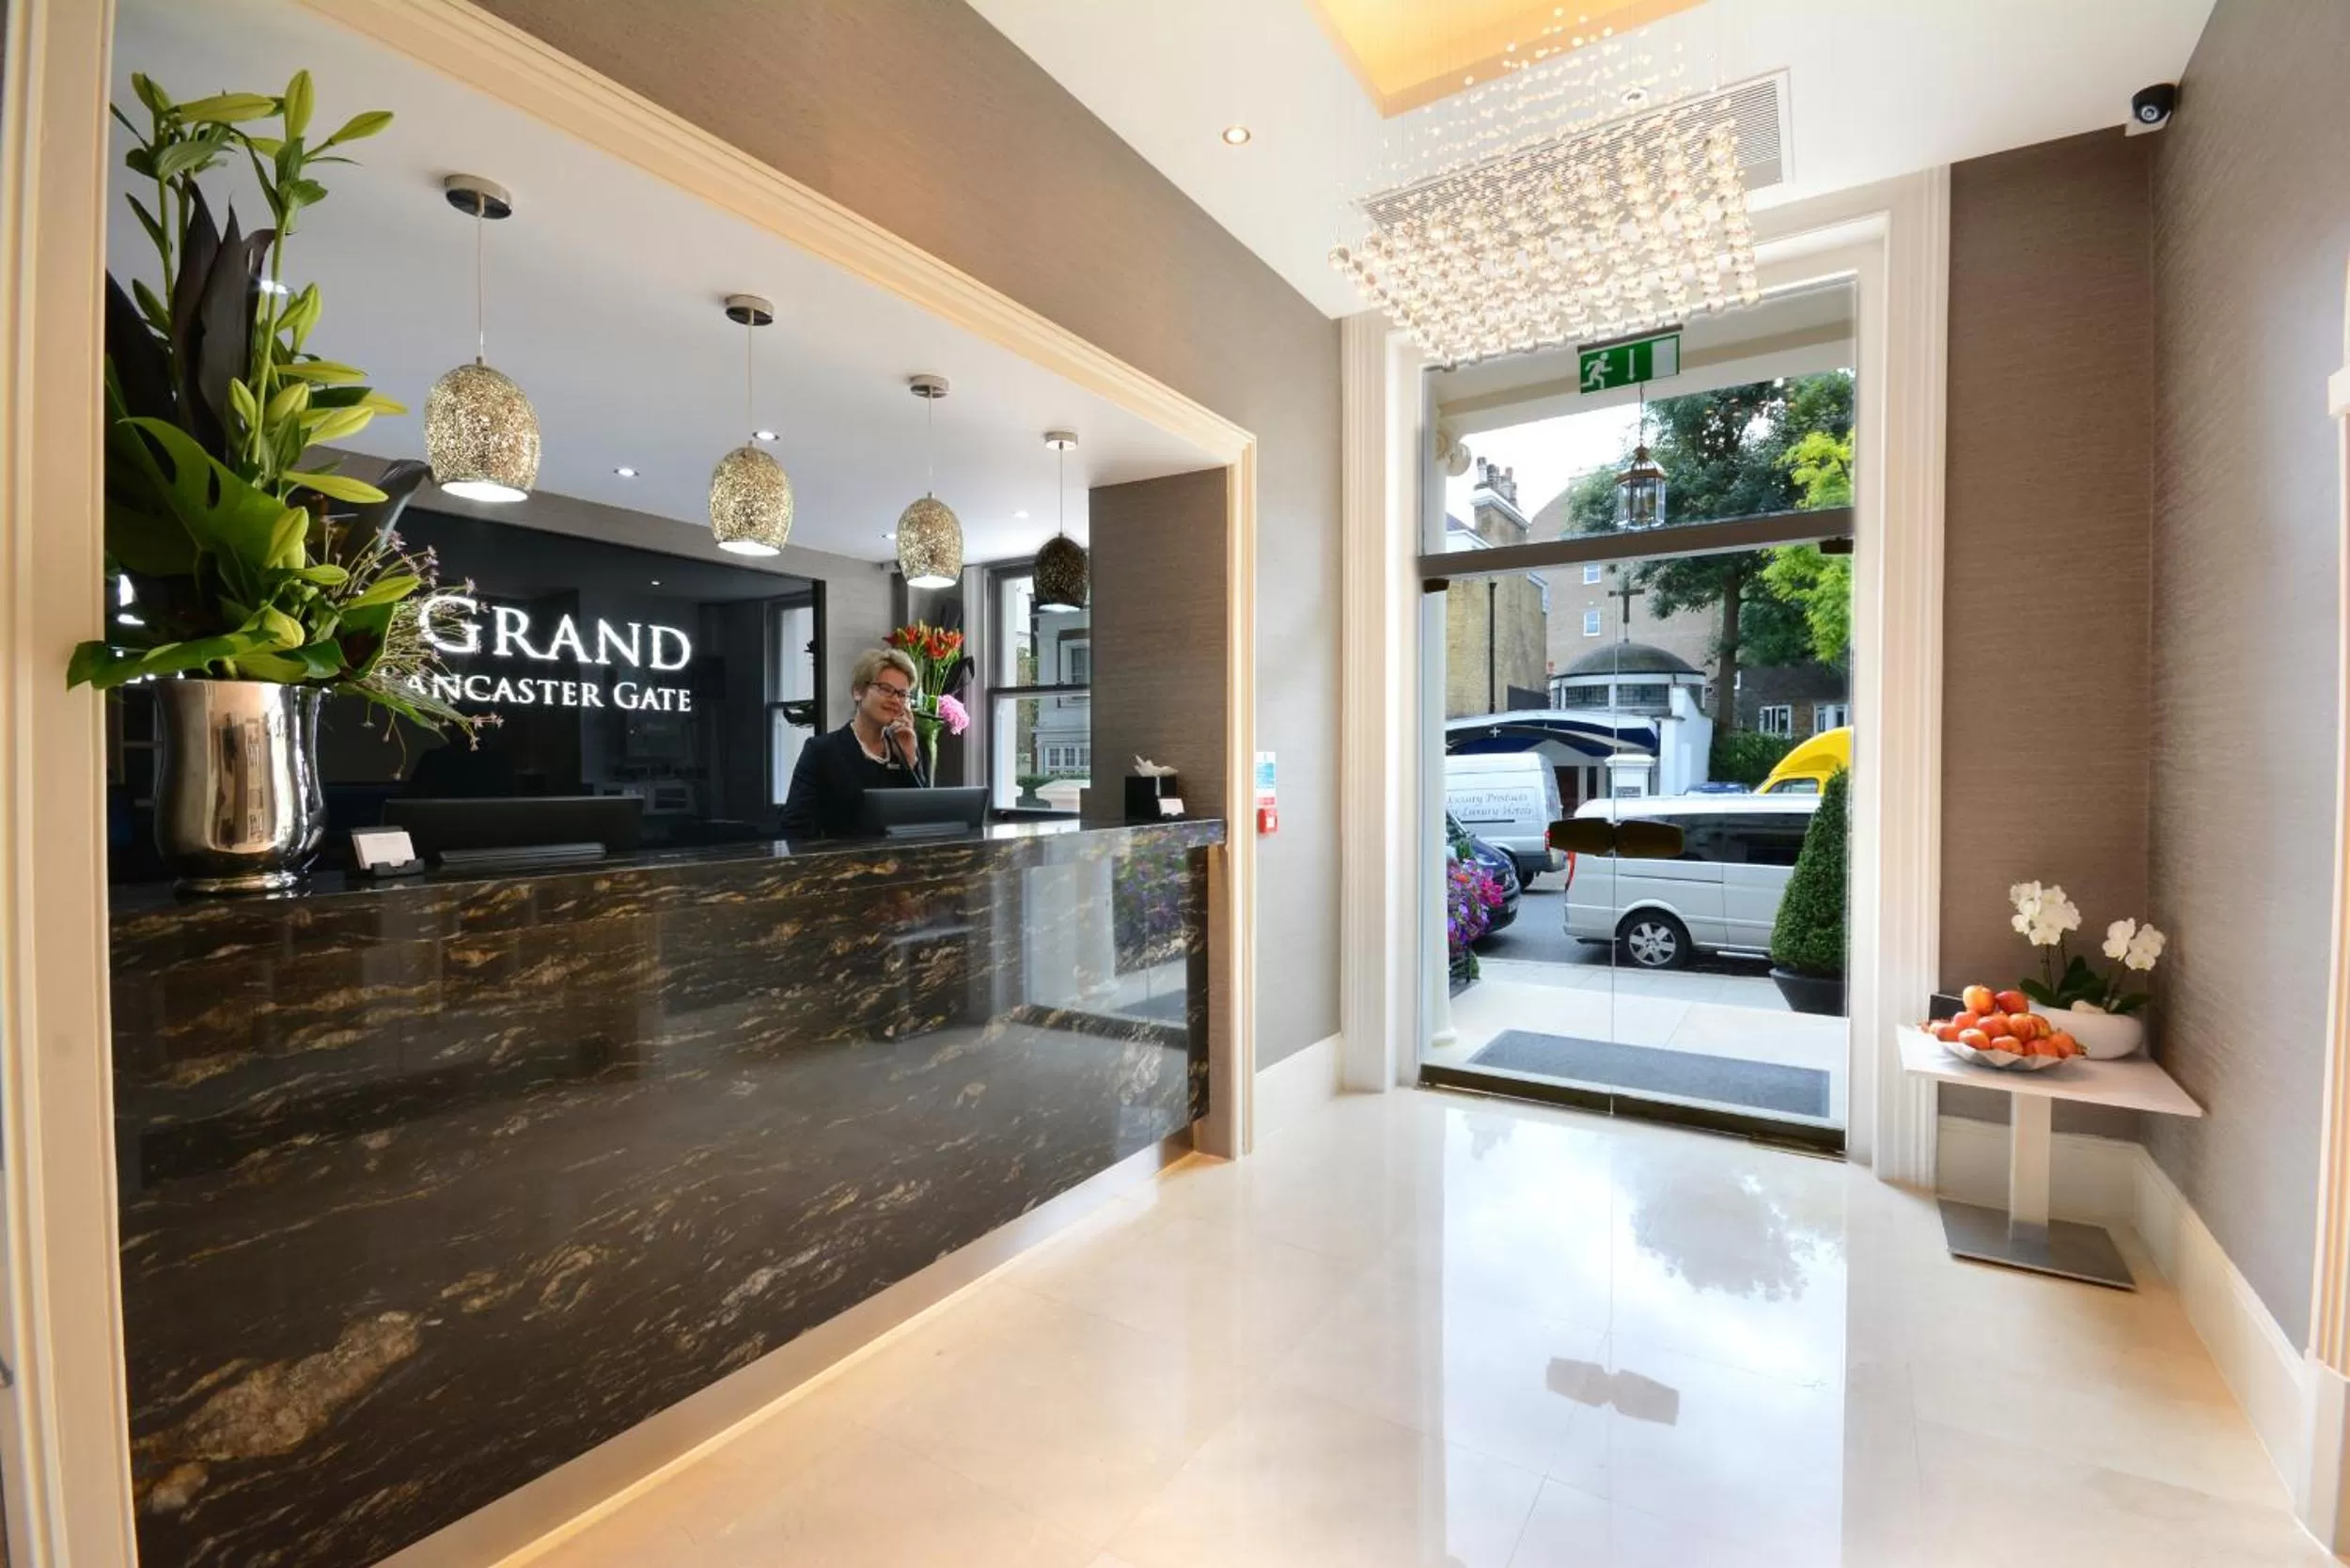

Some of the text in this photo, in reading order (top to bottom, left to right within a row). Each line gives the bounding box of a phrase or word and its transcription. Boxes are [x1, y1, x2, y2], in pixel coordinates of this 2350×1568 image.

[417, 595, 692, 671] GRAND
[382, 666, 693, 713] ANCASTER GATE
